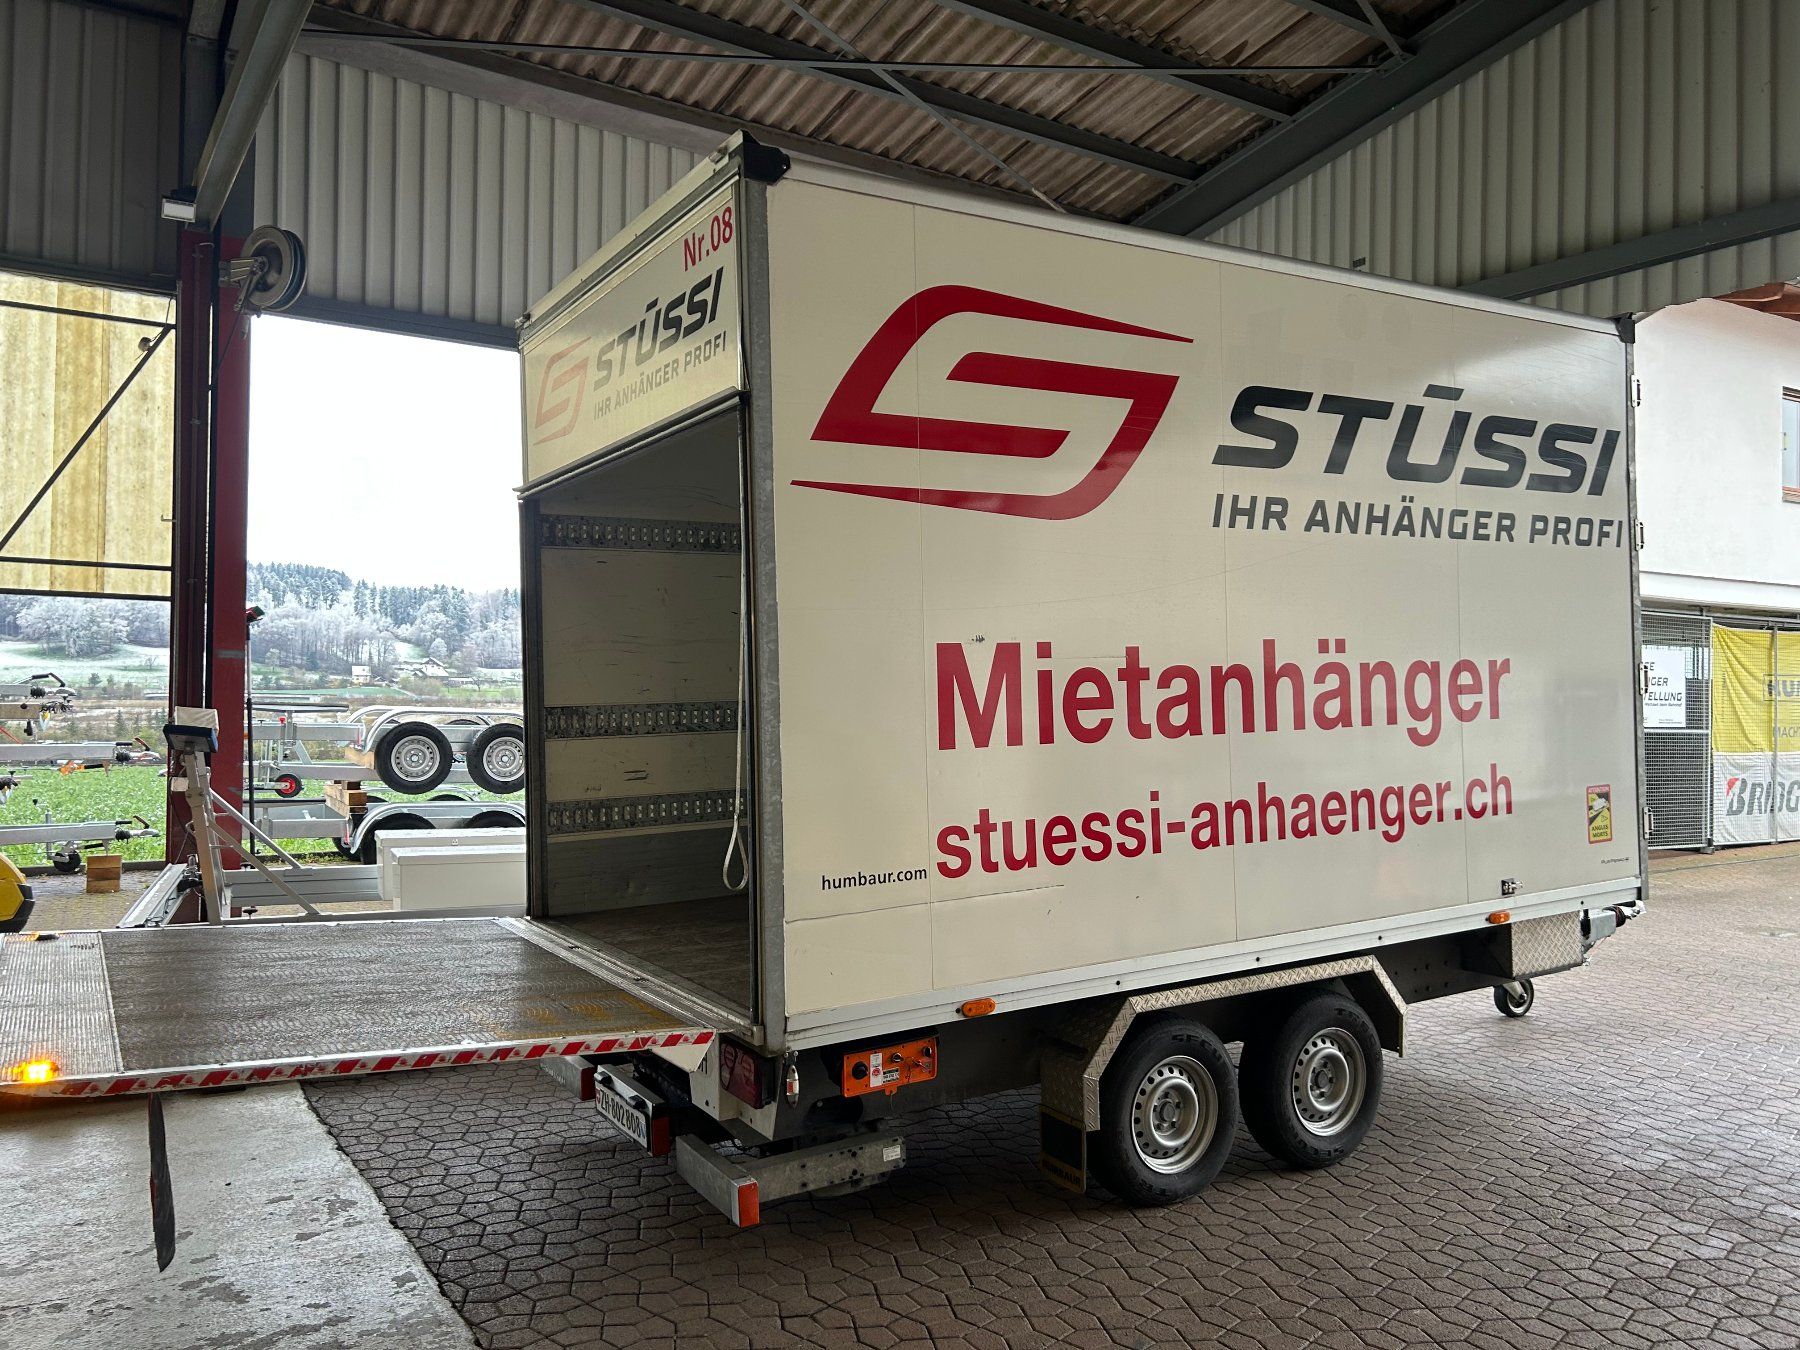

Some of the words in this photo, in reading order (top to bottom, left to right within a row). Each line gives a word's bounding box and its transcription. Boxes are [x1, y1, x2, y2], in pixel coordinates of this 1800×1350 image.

[683, 206, 733, 272] Nr.08
[593, 266, 724, 392] STÜSSI
[594, 398, 611, 421] IHR
[614, 357, 680, 411] ANHÄNGER
[684, 330, 726, 372] PROFI
[1212, 384, 1620, 496] STÜSSI
[1212, 493, 1289, 531] IHR
[1304, 496, 1516, 543] ANHÄNGER
[1529, 514, 1623, 548] PROFI
[936, 638, 1511, 750] Mietanhänger
[936, 763, 1513, 878] stuessi-anhaenger.ch
[821, 867, 927, 890] humbaur.com
